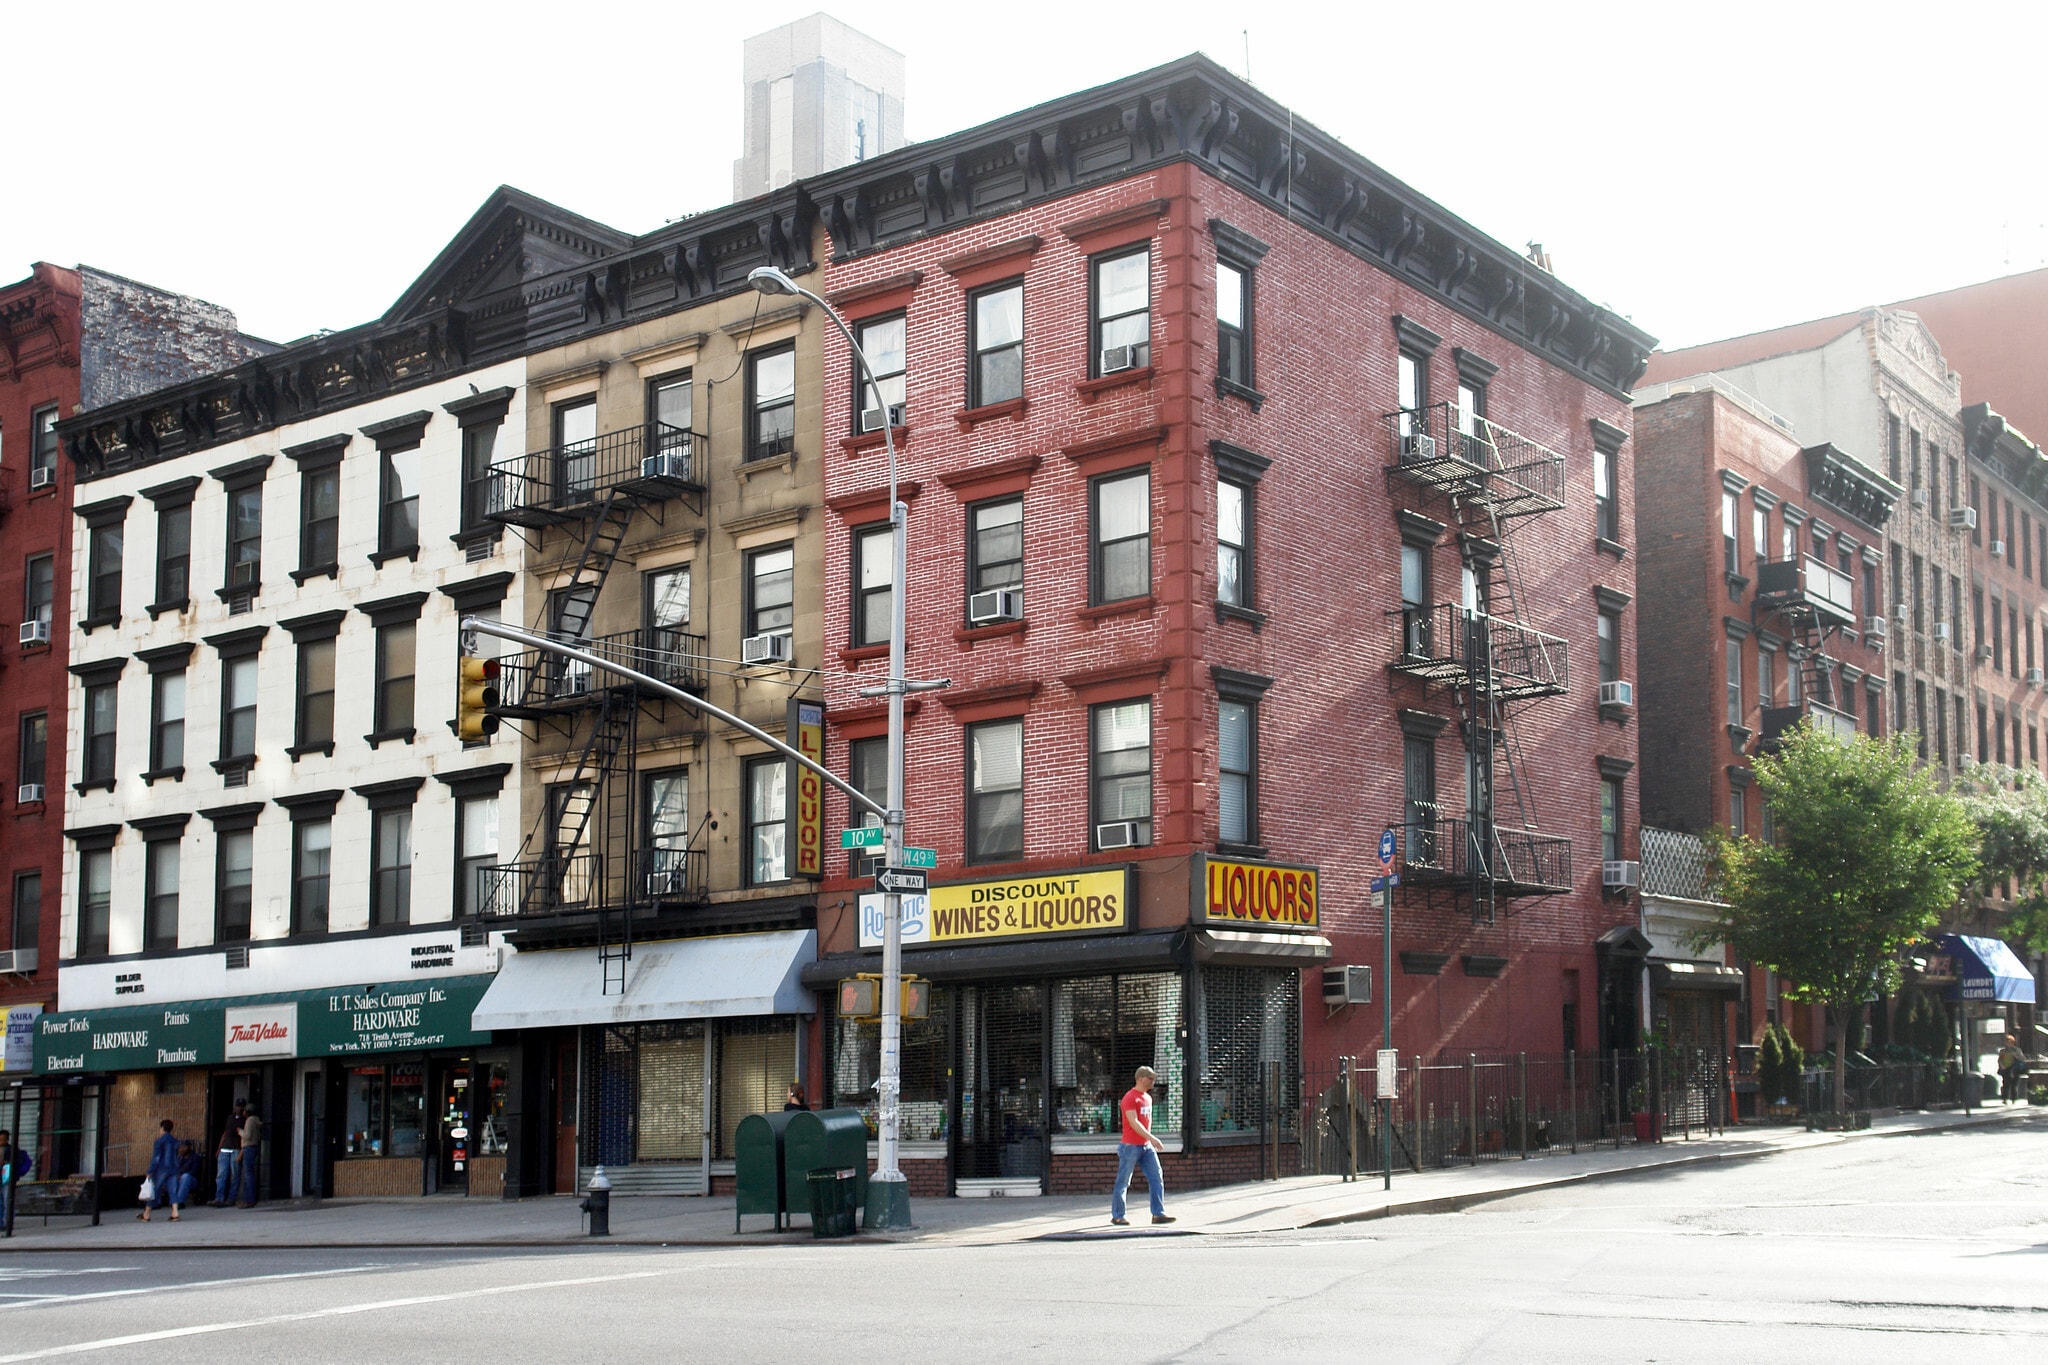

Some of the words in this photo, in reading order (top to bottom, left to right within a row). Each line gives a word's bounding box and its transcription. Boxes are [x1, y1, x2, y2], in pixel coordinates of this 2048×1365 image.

[800, 731, 818, 869] LIQUOR
[851, 831, 865, 846] 10
[866, 830, 876, 838] AV
[928, 852, 935, 860] ST
[884, 875, 899, 886] ONE
[906, 876, 922, 886] WAY
[971, 880, 1080, 904] DISCOUNT
[1209, 864, 1313, 923] LIQUORS
[933, 905, 1000, 936] WINES
[1004, 906, 1018, 927] &
[1021, 894, 1117, 929] LIQUORS
[411, 944, 455, 956] INDUSTRIAL
[411, 957, 454, 970] HARDWARE
[115, 974, 142, 983] BUILDER
[1964, 978, 1993, 987] LAUNDRY
[115, 984, 144, 994] SUPPLIES
[1963, 988, 1994, 998] CLEANERS
[329, 996, 341, 1012] H.
[342, 996, 352, 1010] T.
[354, 992, 379, 1010] Sales
[380, 990, 426, 1009] Company
[428, 987, 447, 1002] Inc.
[10, 1012, 33, 1021] SAIRA
[164, 1011, 190, 1026] Paints
[353, 1008, 421, 1031] HARDWARE
[42, 1020, 68, 1035] Power
[69, 1017, 90, 1032] Tools
[92, 1030, 149, 1050] HARDWARE
[330, 1044, 346, 1052] New
[361, 1042, 372, 1050] NY
[374, 1040, 392, 1049] 10019
[398, 1035, 444, 1047] 212-265-0747
[358, 1034, 370, 1042] 718
[372, 1032, 390, 1041] Tenth
[391, 1030, 415, 1040] Avenue
[48, 1054, 84, 1071] Electrical
[158, 1048, 198, 1064] Plumbing
